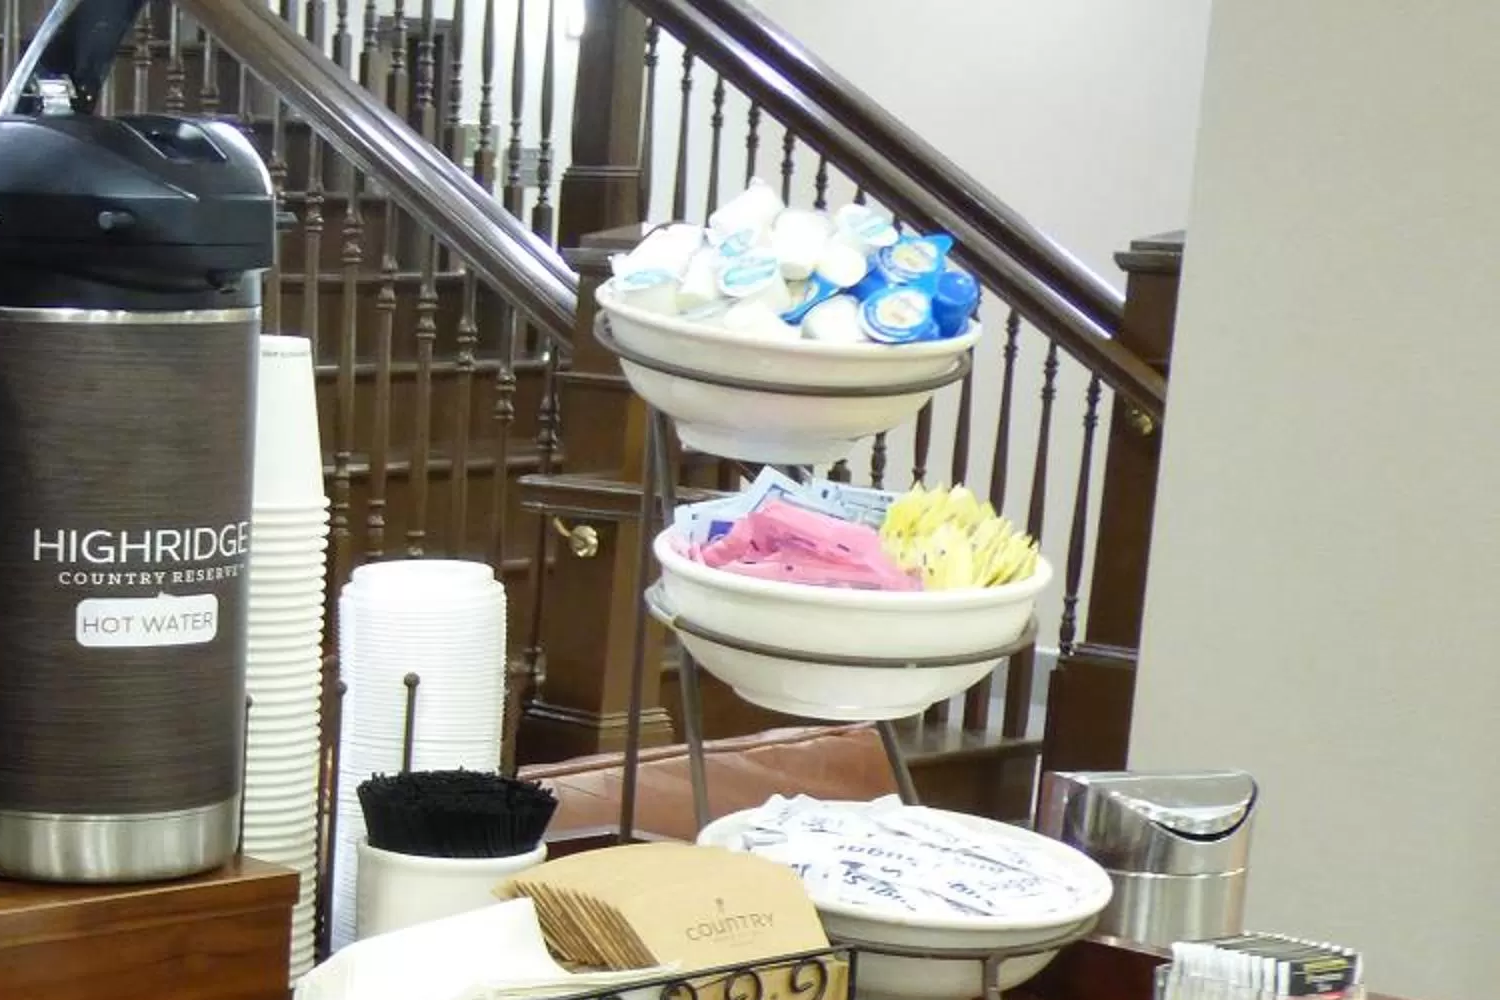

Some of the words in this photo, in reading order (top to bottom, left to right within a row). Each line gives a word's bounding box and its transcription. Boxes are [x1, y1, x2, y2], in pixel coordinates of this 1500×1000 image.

[33, 521, 249, 563] HIGHRIDGE
[58, 571, 167, 586] COUNTRY
[172, 565, 238, 584] RESERVE
[83, 615, 136, 635] HOT
[142, 611, 214, 634] WATER
[685, 912, 775, 942] COUNTRY
